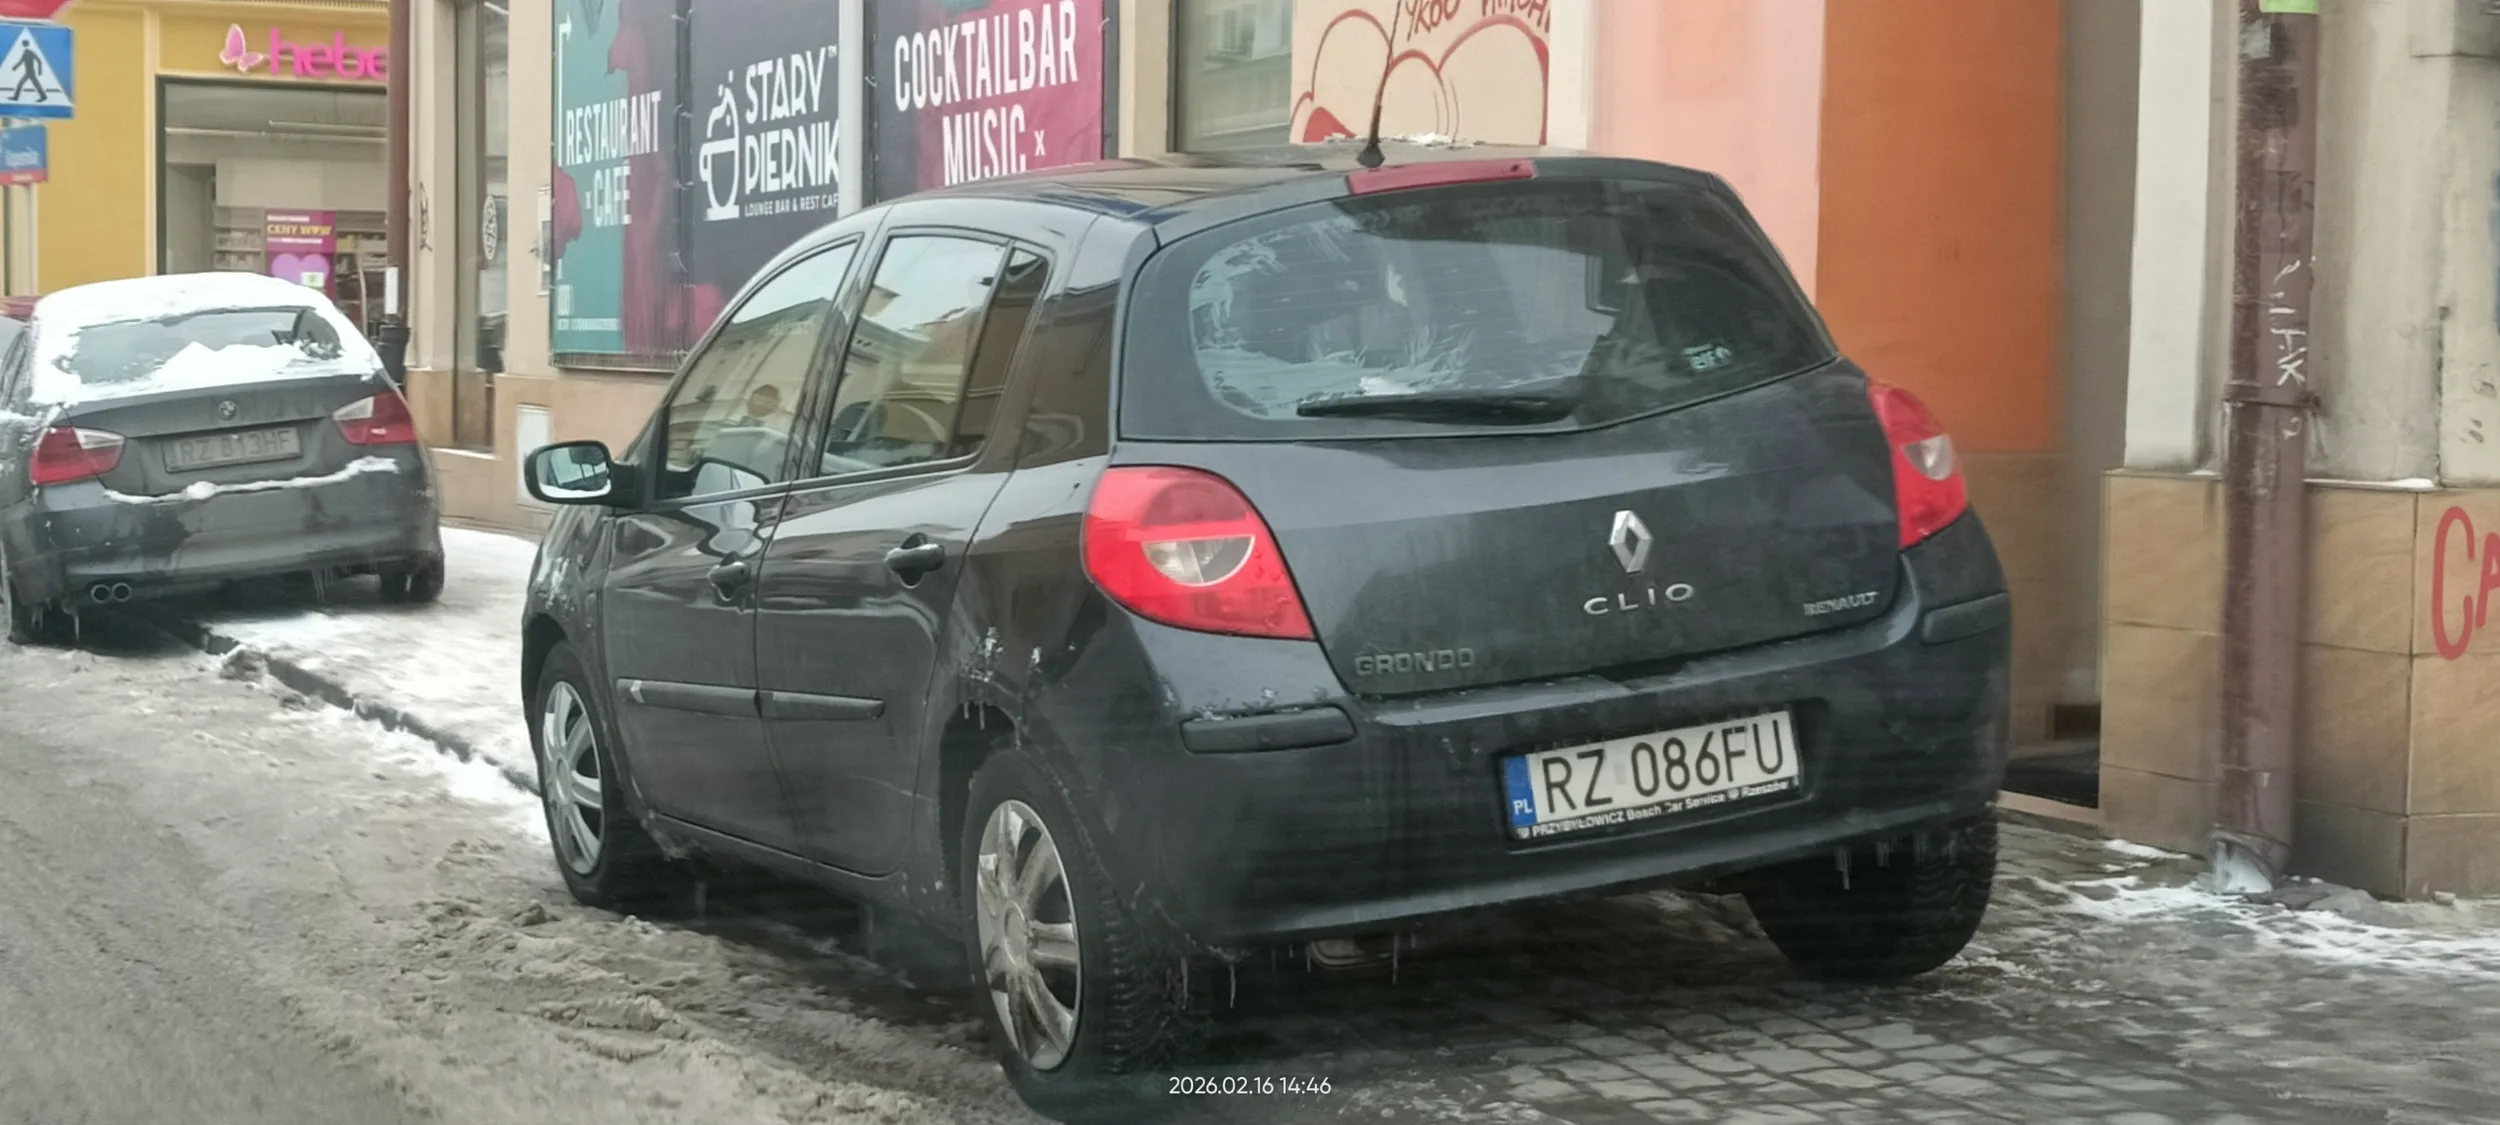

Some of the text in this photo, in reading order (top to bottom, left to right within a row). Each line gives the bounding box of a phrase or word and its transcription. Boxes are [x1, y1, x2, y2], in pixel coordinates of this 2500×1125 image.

[894, 0, 1078, 112] COCKTAILBAR
[745, 47, 826, 125] STARY
[566, 90, 662, 166] RESTAURANT
[942, 104, 1027, 187] MUSIC
[744, 119, 839, 195] PIERNIK
[594, 159, 632, 228] CAFÉ
[745, 200, 773, 217] LOUNGE
[775, 198, 790, 214] BAR
[800, 195, 820, 210] REST
[822, 192, 839, 209] CAF
[180, 438, 213, 464] RZ
[1584, 583, 1694, 615] CLIO
[1803, 591, 1880, 616] RENAULT
[1354, 648, 1474, 676] GRONDO
[1541, 719, 1784, 814] RZ 086FU
[1512, 798, 1533, 815] PL
[1626, 805, 1662, 821] Bosch
[1685, 793, 1726, 810] Service
